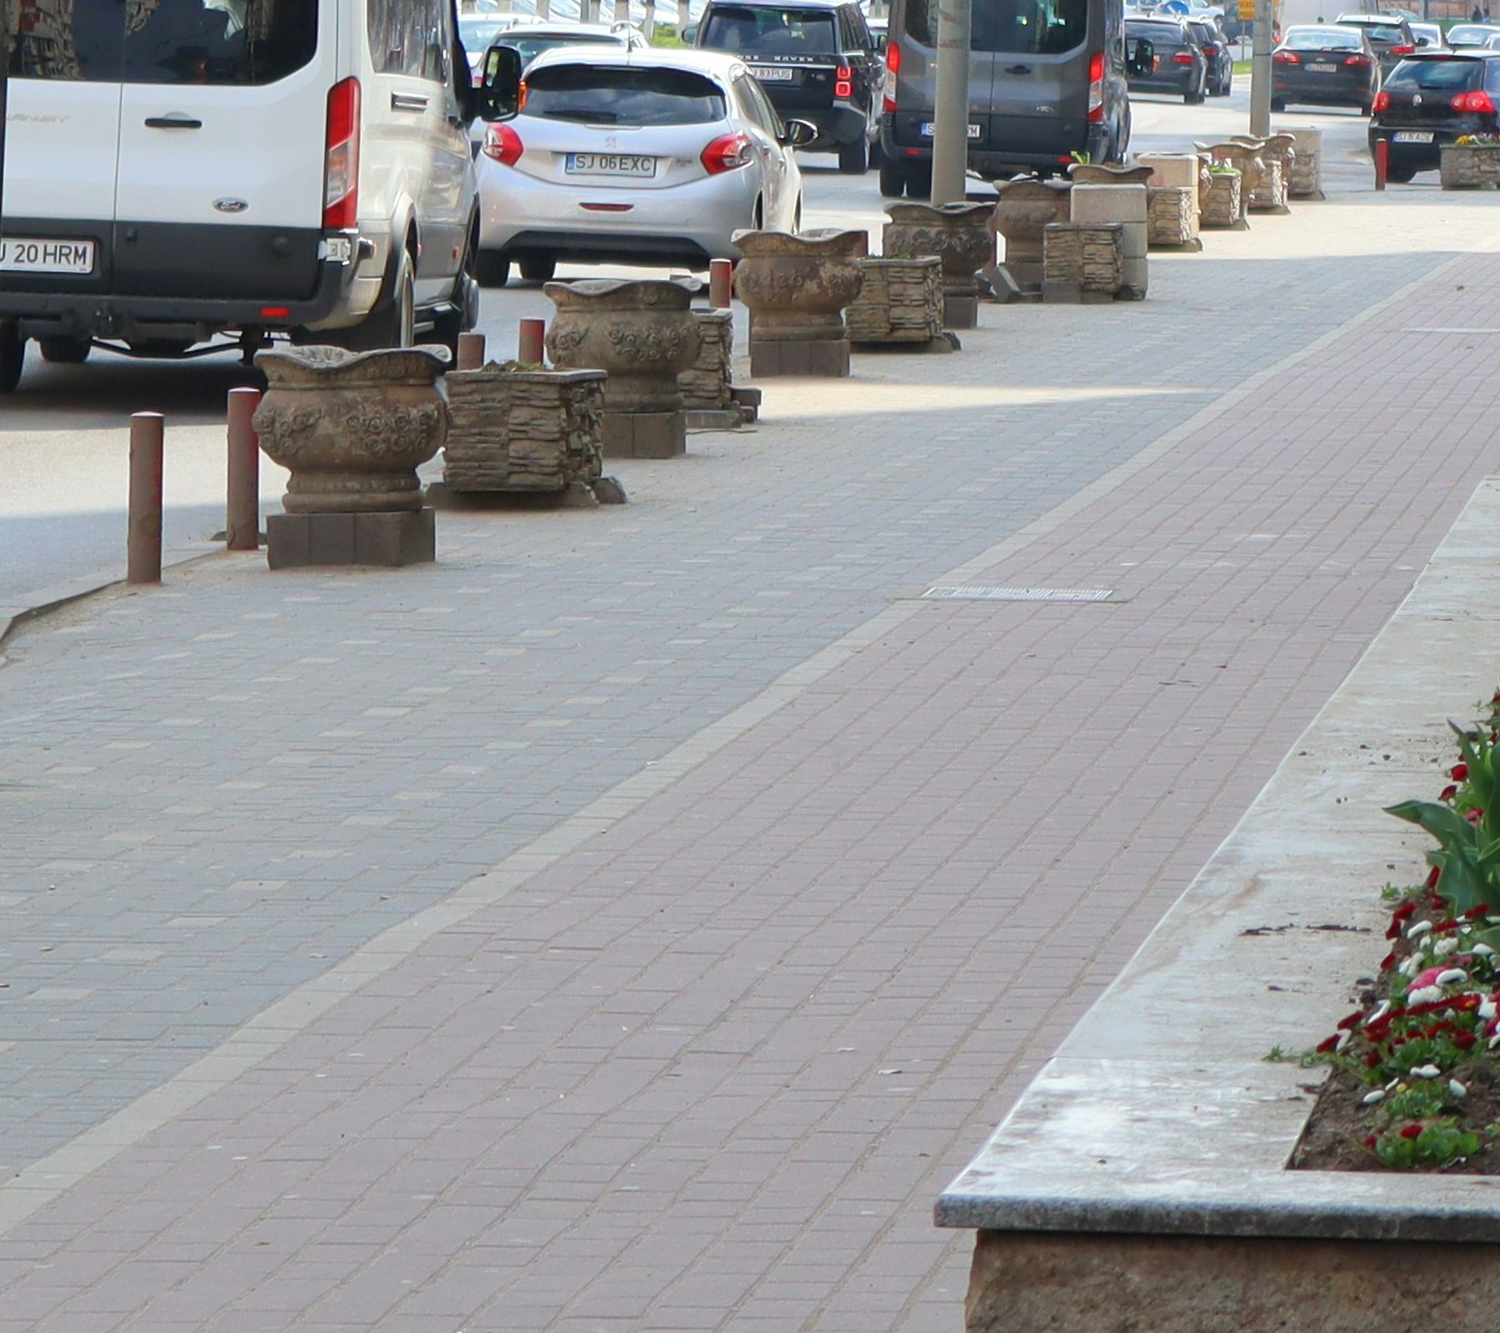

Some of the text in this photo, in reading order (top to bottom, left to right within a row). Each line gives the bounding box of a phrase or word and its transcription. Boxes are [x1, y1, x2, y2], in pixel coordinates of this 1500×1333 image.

[575, 155, 595, 169] SJ
[13, 243, 39, 263] 20
[42, 244, 87, 265] HRM
